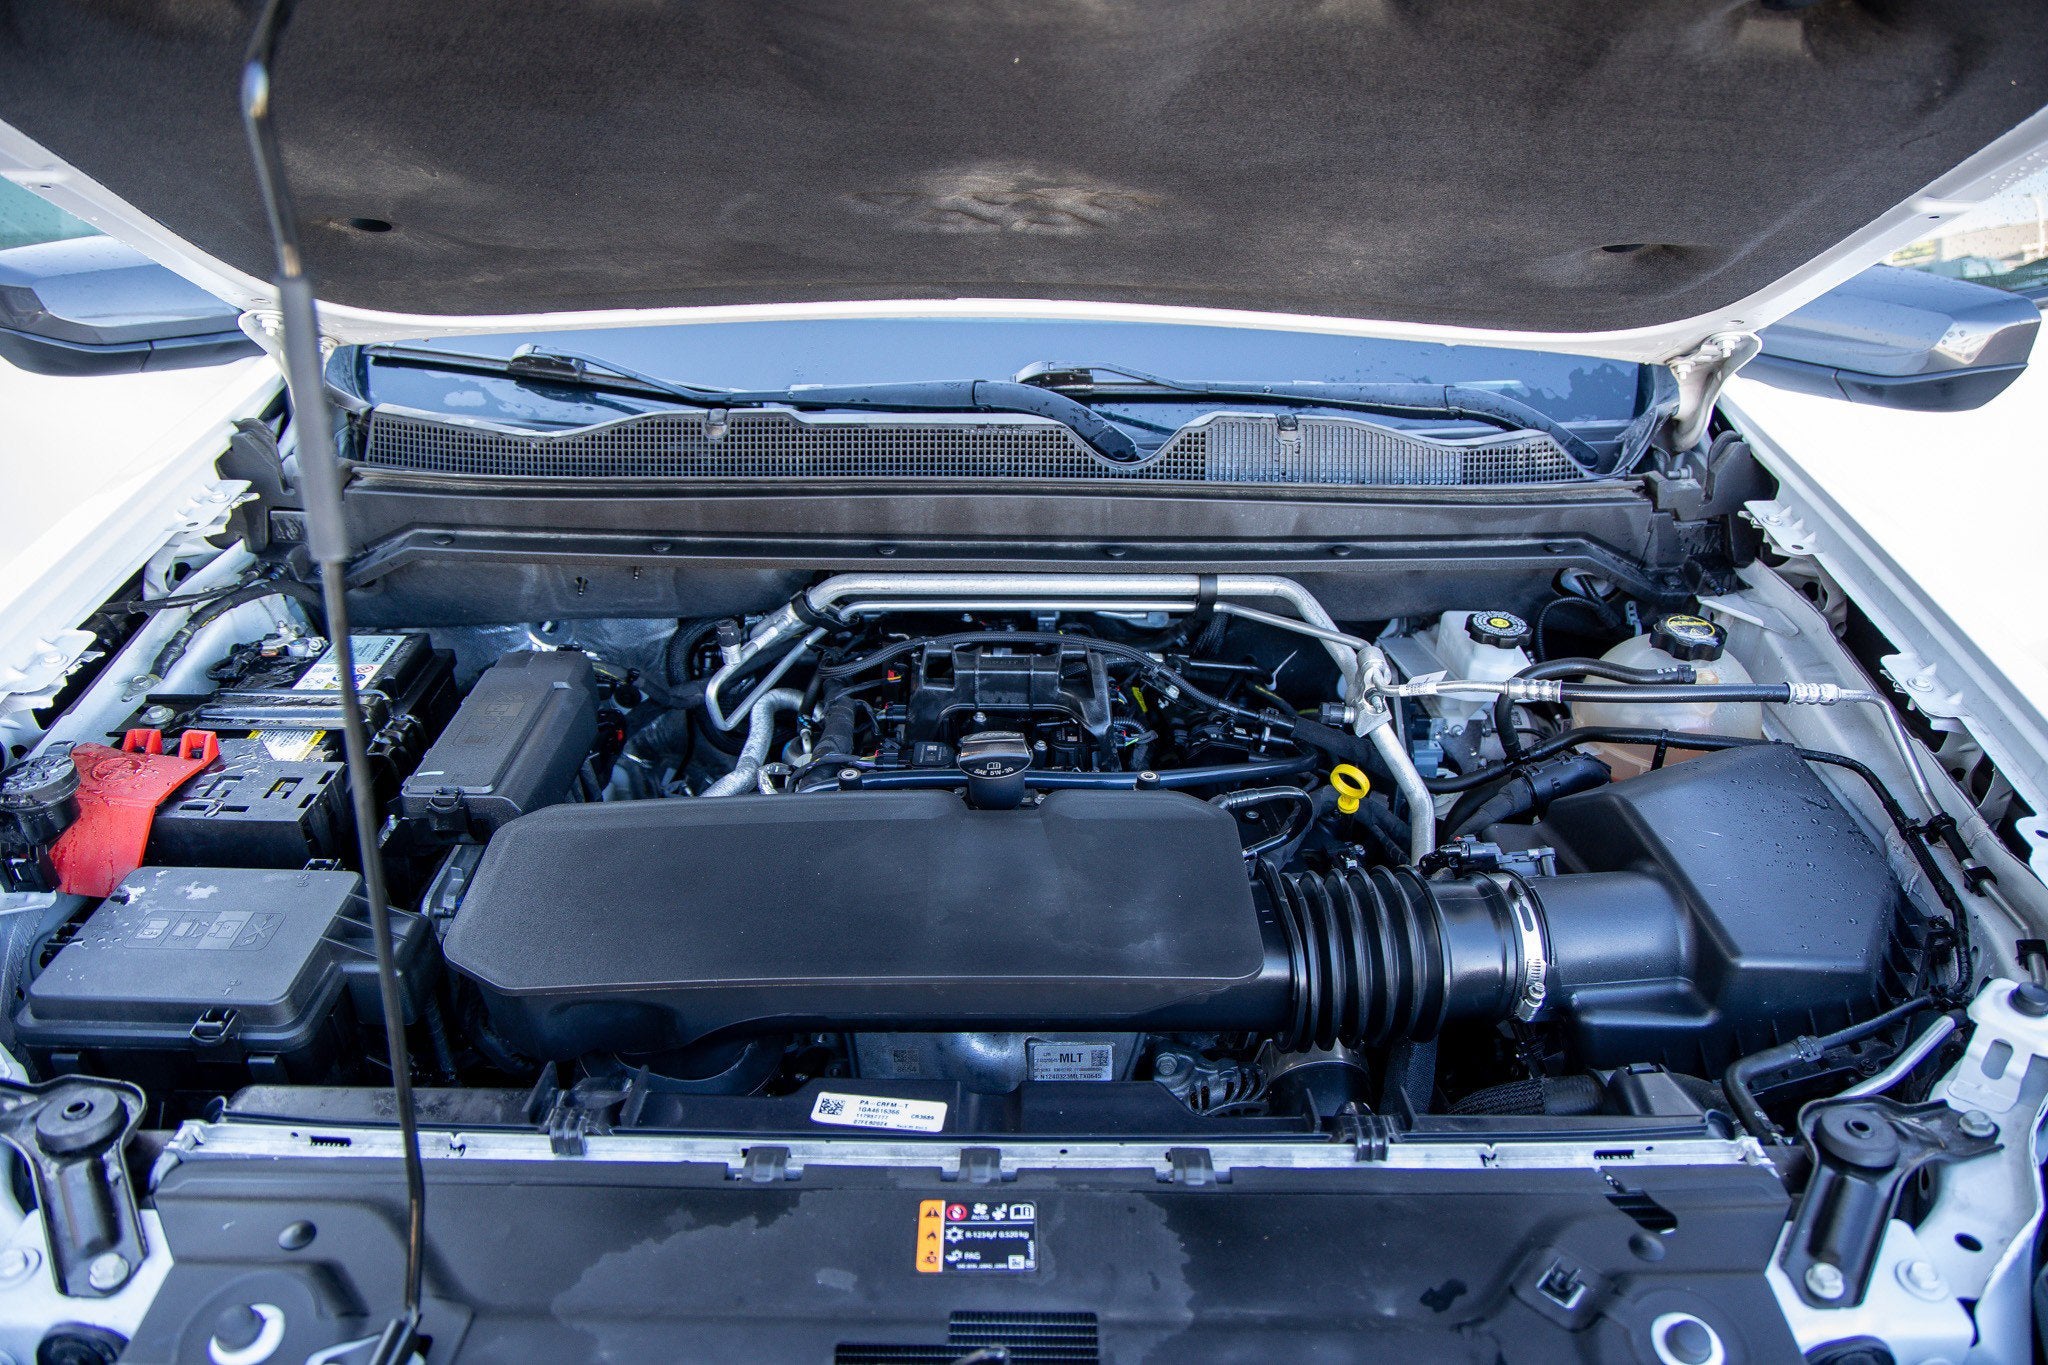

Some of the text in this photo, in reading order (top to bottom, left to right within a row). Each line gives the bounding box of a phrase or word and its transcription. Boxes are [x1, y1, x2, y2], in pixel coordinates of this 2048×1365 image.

[373, 637, 396, 662] ACDelco
[990, 766, 1014, 776] 5W-30
[1059, 1052, 1083, 1063] MLT
[964, 1251, 981, 1260] PAG
